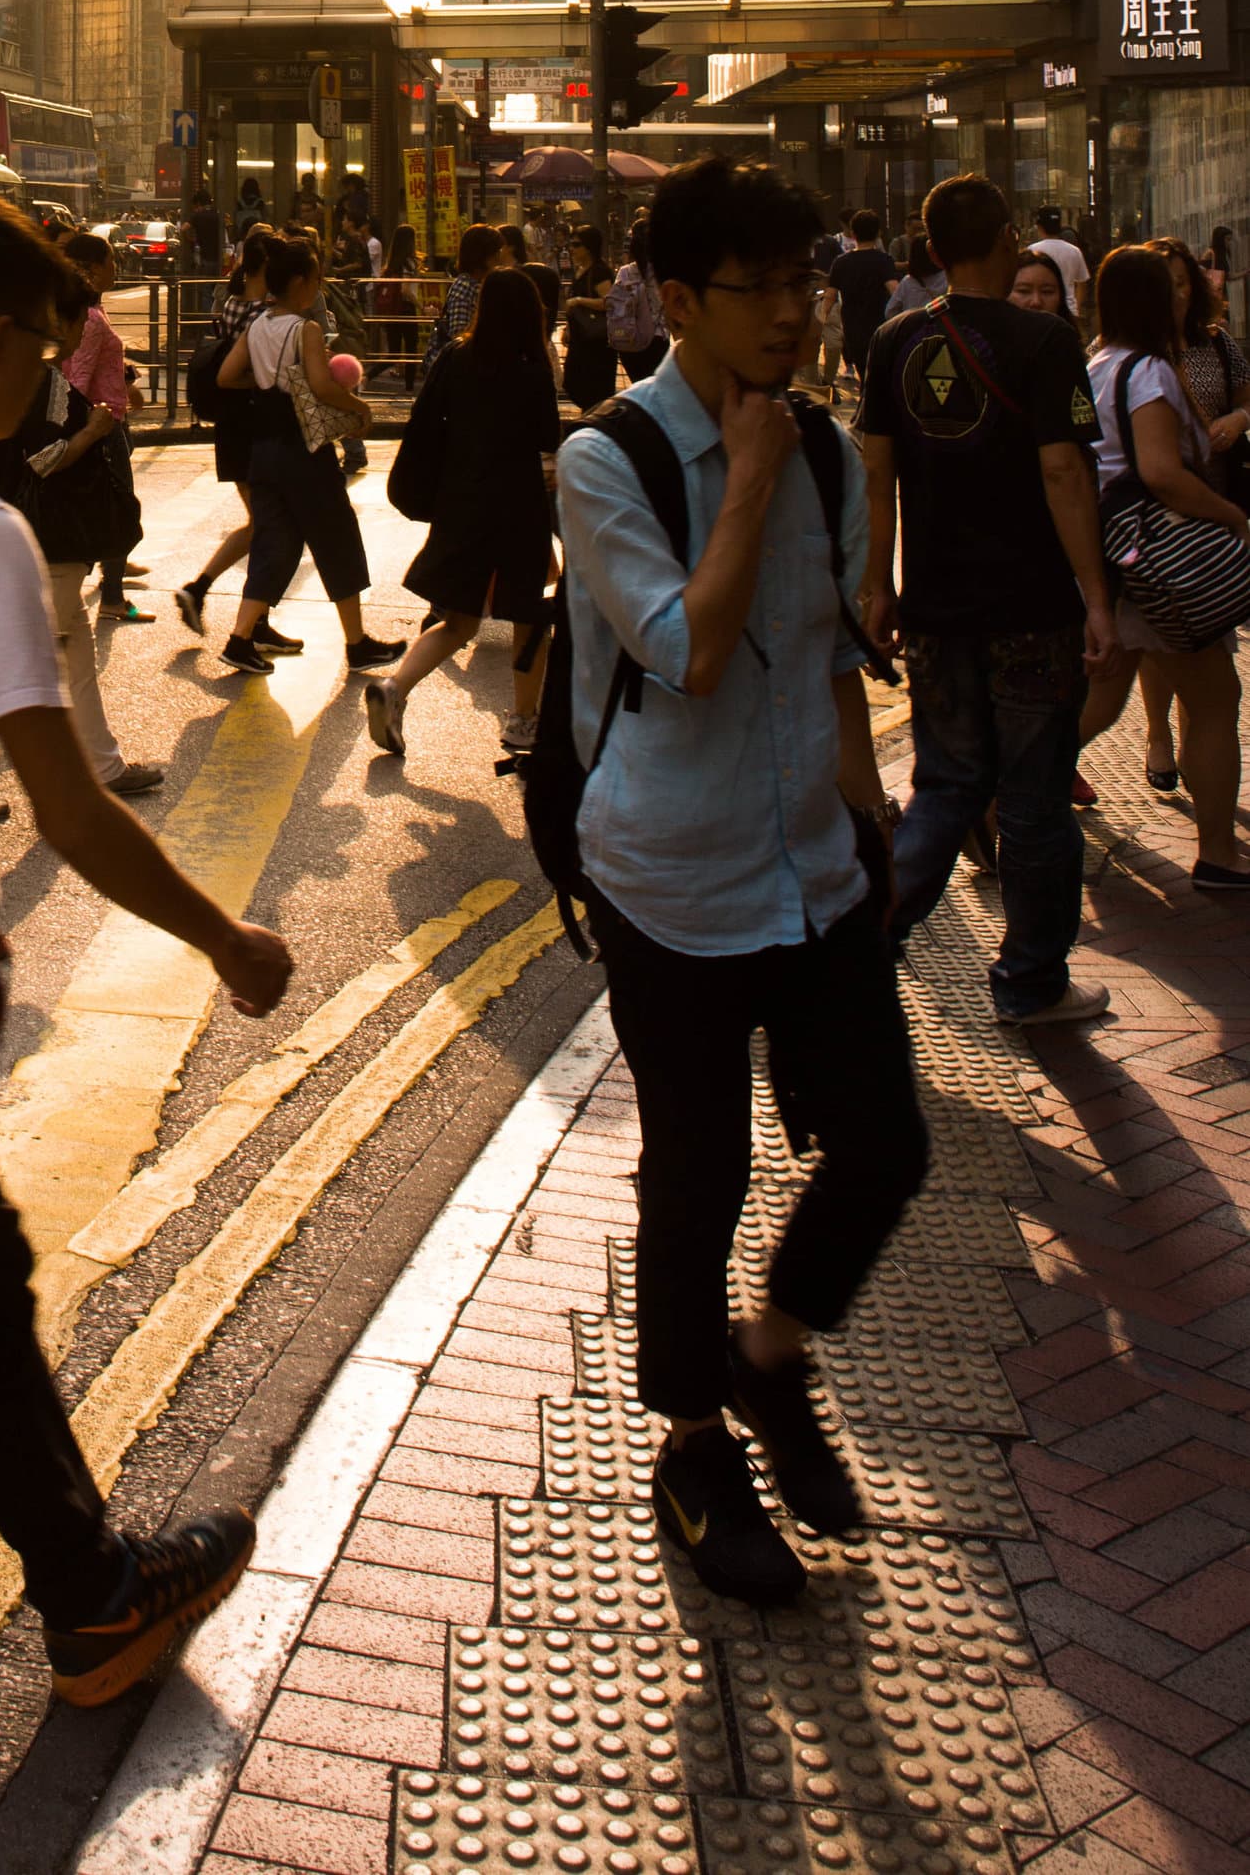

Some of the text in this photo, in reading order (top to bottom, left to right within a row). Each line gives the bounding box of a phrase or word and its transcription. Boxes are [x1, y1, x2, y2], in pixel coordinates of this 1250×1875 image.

[1120, 37, 1203, 60] Chow Sang Sang
